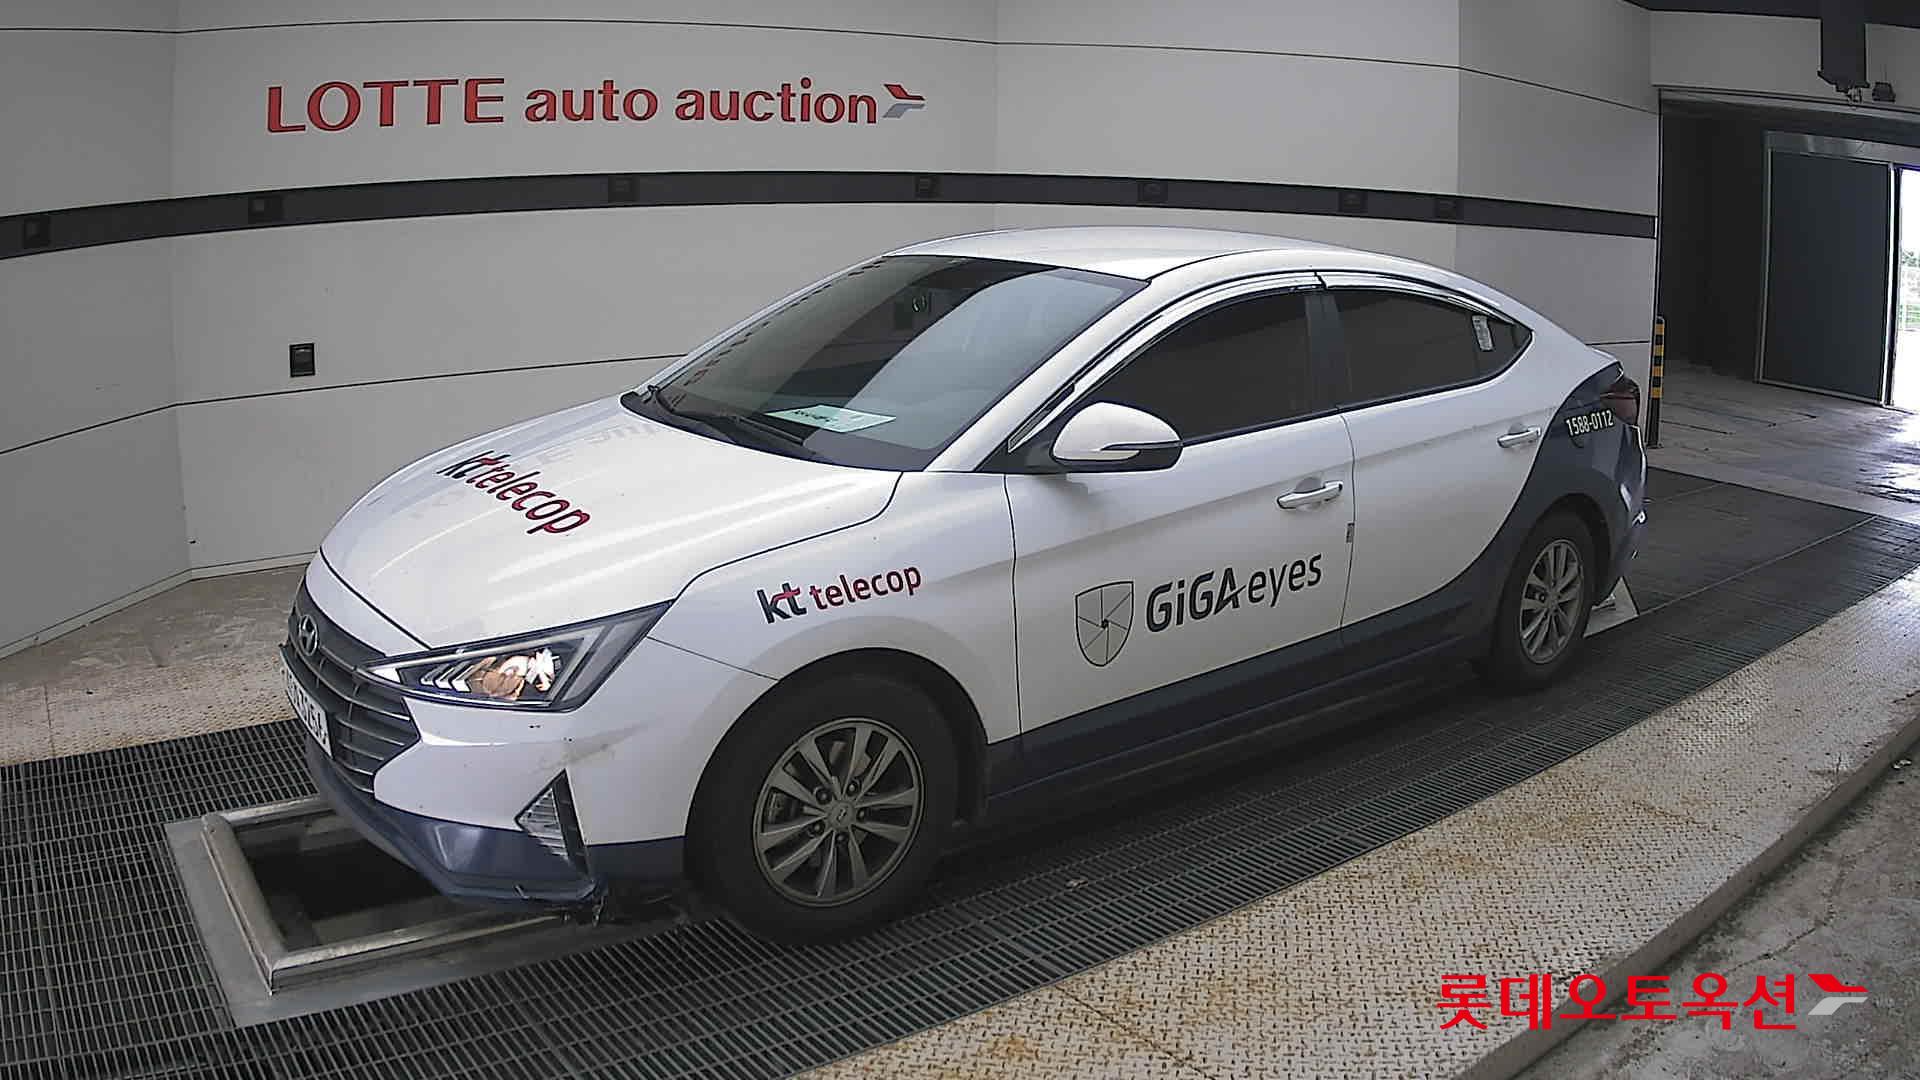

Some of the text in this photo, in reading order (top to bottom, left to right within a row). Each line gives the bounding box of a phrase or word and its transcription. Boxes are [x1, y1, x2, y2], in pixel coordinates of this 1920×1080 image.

[267, 77, 878, 133] LOTTE auto auction
[1566, 410, 1614, 436] 1588-0112
[466, 464, 591, 534] telecop
[756, 566, 922, 624] kt telecop
